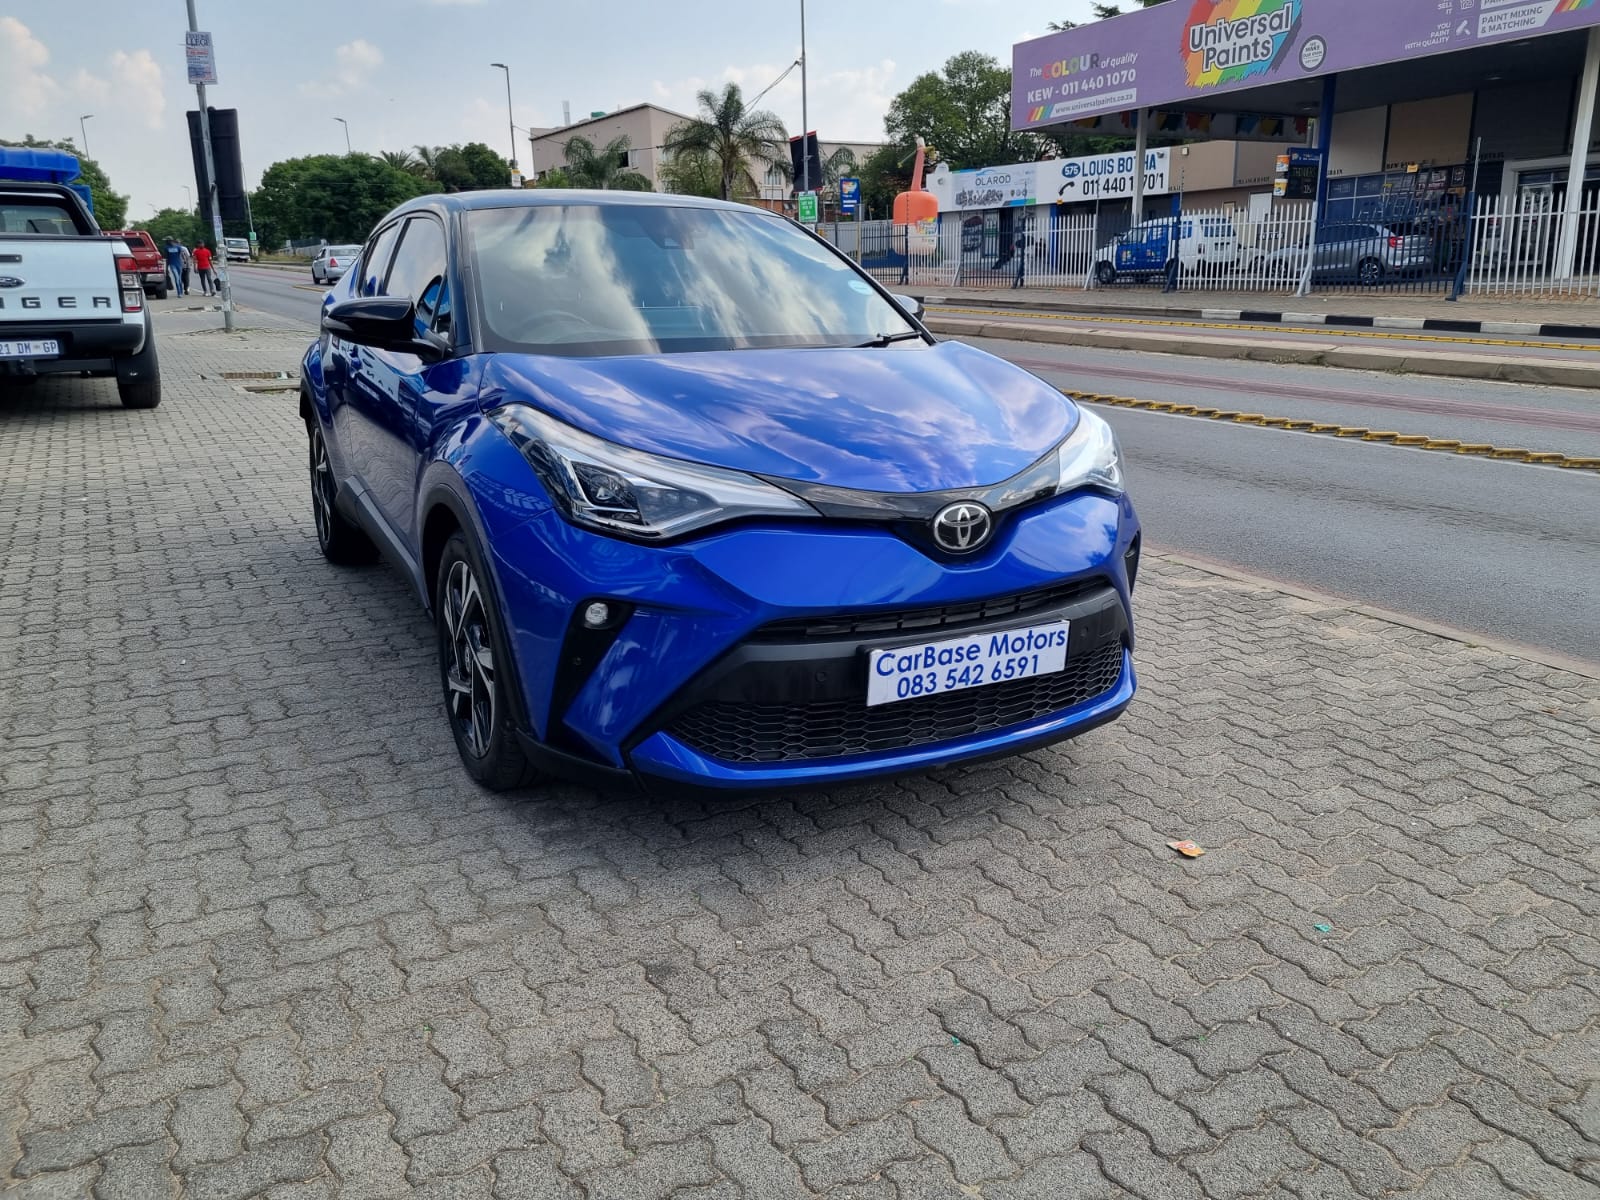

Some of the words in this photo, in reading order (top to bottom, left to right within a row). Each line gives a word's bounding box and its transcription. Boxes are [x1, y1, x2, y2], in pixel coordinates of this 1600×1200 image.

[1482, 13, 1508, 25] PAINT
[1510, 6, 1544, 18] MIXING
[1489, 17, 1536, 33] MATCHING
[1190, 3, 1292, 50] Universal
[1430, 29, 1450, 38] PAINT
[1422, 36, 1449, 48] QUALITY
[1203, 37, 1272, 71] Paints
[1030, 68, 1042, 78] The
[1042, 53, 1100, 80] COLOUR
[1100, 59, 1110, 69] of
[1110, 52, 1138, 68] quality
[1027, 86, 1054, 103] KEW
[1061, 81, 1079, 96] 011
[1081, 75, 1104, 91] 440
[1106, 68, 1136, 87] 1070
[1064, 166, 1078, 176] 575
[1082, 158, 1114, 177] LOUIS
[1117, 153, 1157, 174] BOHA
[975, 174, 1011, 186] OLAROD
[1083, 179, 1100, 195] 011
[1103, 177, 1126, 194] 440
[0, 296, 111, 309] GER
[43, 341, 57, 353] GP
[876, 643, 981, 677] CarBase
[988, 629, 1066, 658] Motors
[896, 671, 938, 698] 083
[944, 663, 984, 690] 542
[991, 654, 1039, 682] 6591
